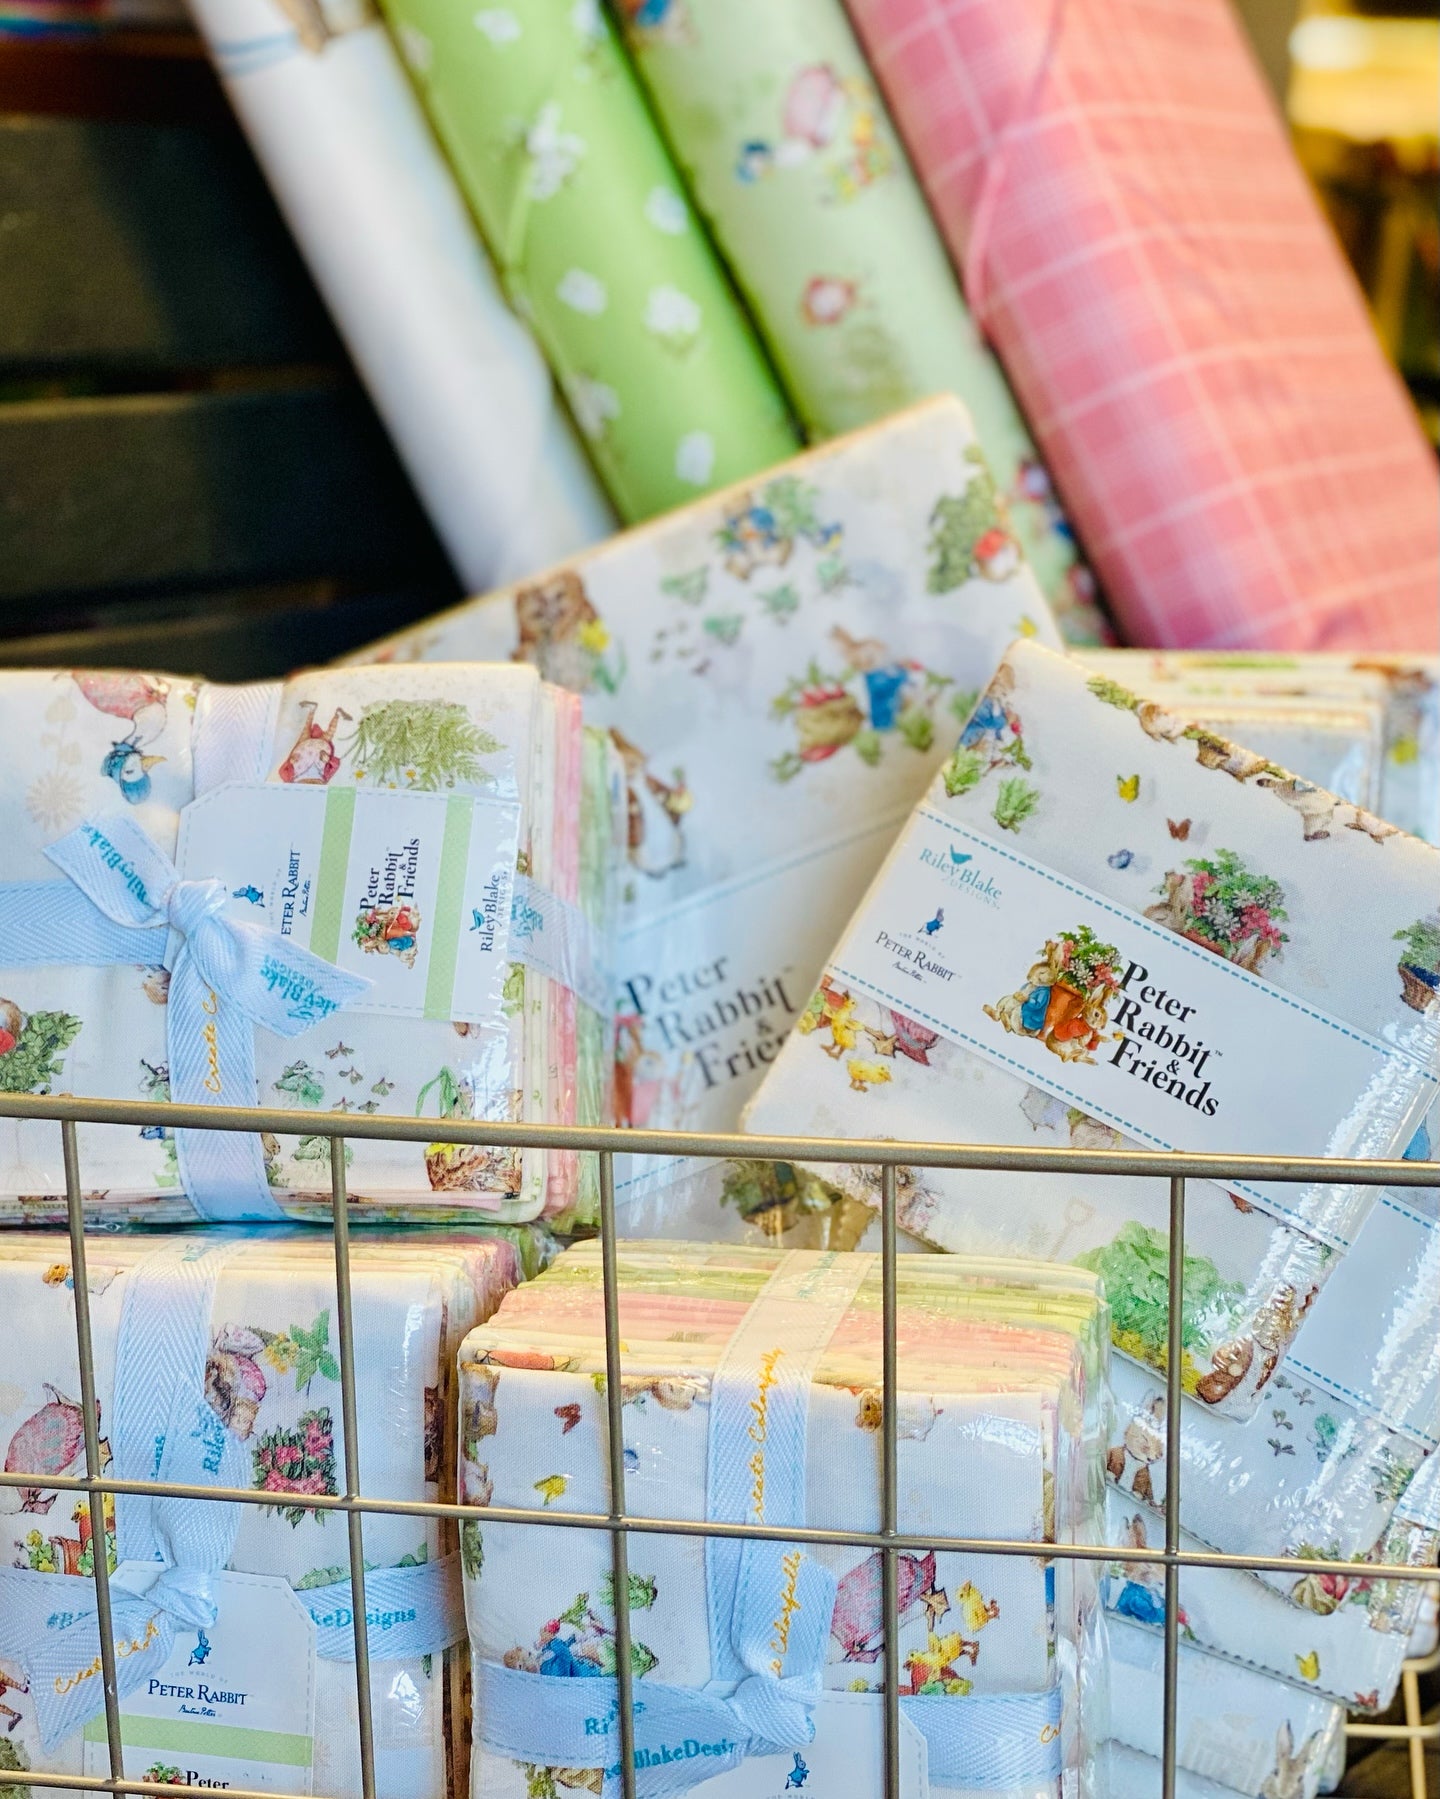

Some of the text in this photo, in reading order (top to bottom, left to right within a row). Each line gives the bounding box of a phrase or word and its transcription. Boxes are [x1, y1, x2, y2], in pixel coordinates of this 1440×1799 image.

[281, 849, 301, 935] ETER RABBIT
[359, 867, 381, 910] Peter
[378, 852, 404, 906] Rabbit
[397, 838, 420, 899] Friends
[398, 863, 407, 871] &
[622, 955, 728, 1015] Peter
[875, 941, 912, 970] PETER
[913, 951, 957, 992] RABBIT
[1118, 960, 1197, 1023] Peter
[656, 976, 797, 1050] Rabbit
[1111, 996, 1212, 1079] Rabbit
[203, 1021, 221, 1094] Create
[1107, 1036, 1220, 1117] Friends
[1166, 1059, 1181, 1076] &
[749, 1450, 766, 1525] reate
[55, 1657, 103, 1694] Creat
[147, 1679, 248, 1706] PETER RABBIT
